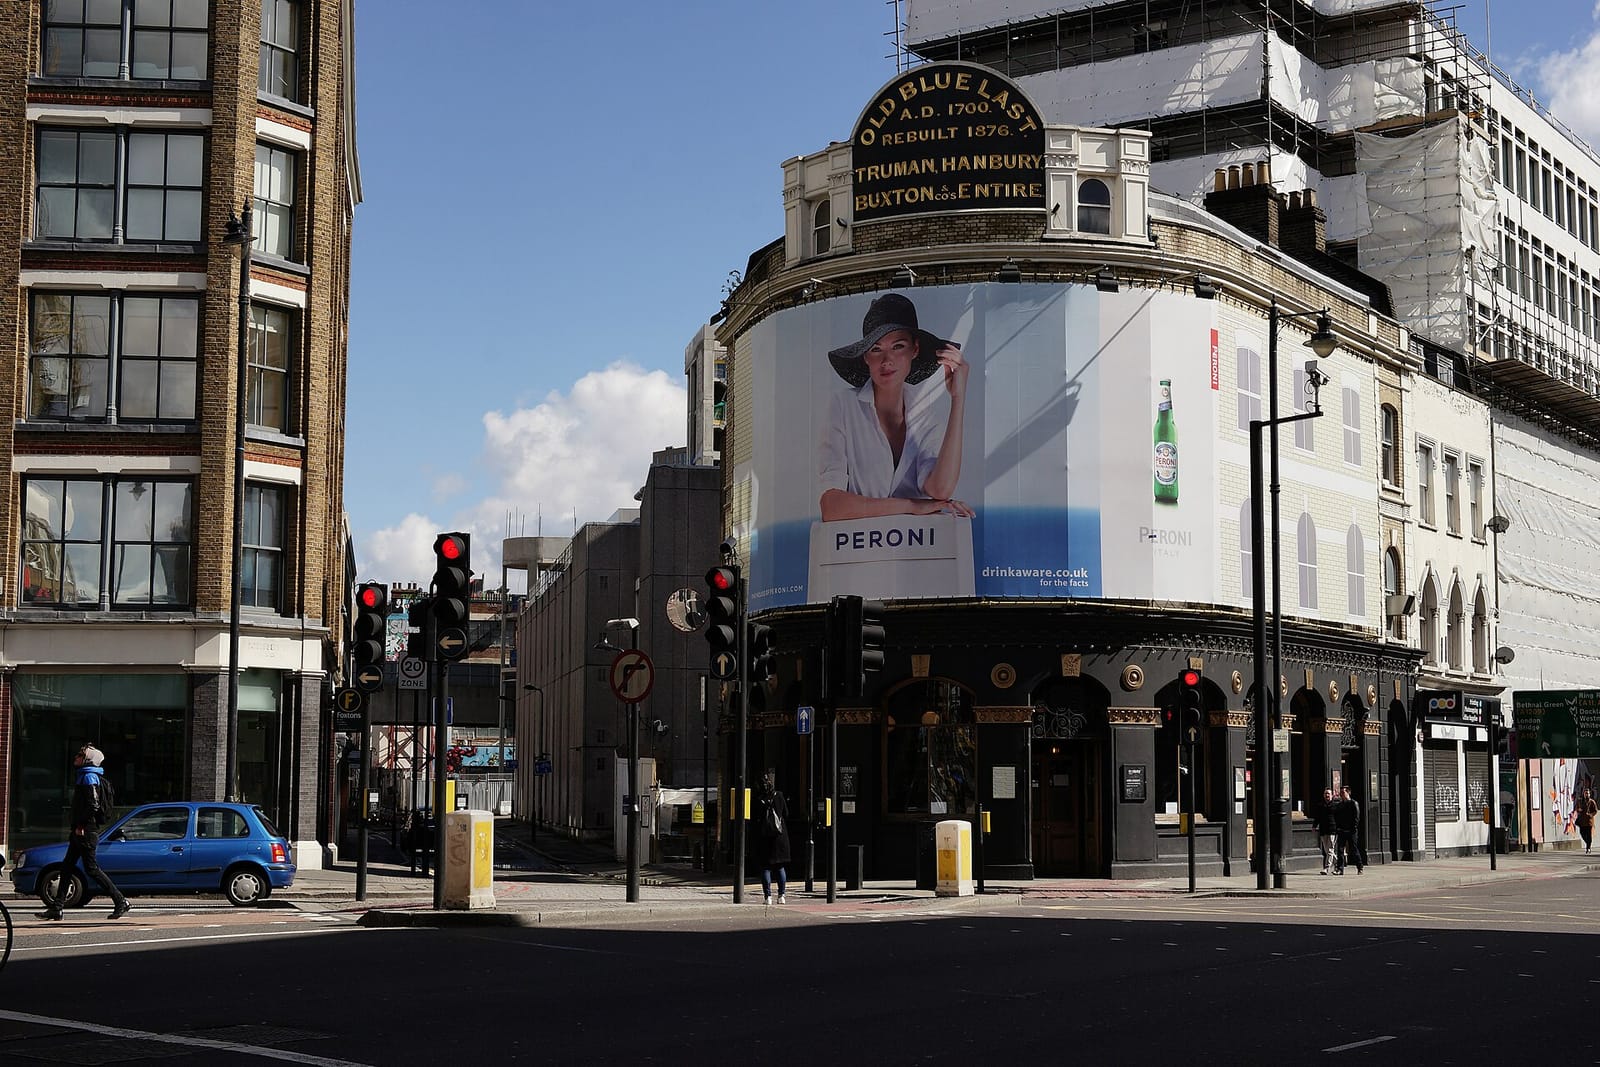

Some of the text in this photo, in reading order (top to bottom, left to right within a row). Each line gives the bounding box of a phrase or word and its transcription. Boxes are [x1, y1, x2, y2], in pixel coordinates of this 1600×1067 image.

[860, 98, 896, 146] OLD
[898, 72, 972, 101] BLUE
[899, 101, 992, 121] A.D. 1700.
[882, 124, 1014, 146] REBUILT 1876.
[855, 158, 938, 184] TRUMAN,
[934, 191, 957, 201] CO'S
[940, 184, 949, 192] &
[855, 186, 934, 212] BUXTON
[836, 527, 935, 551] PERONI
[1138, 526, 1192, 546] PERONI
[982, 566, 1088, 578] drinkaware.co.uk
[1040, 579, 1089, 587] for the facts
[405, 661, 421, 672] 20
[401, 679, 424, 687] ZONE
[344, 692, 355, 709] F
[1428, 694, 1456, 713] pod
[336, 711, 362, 719] Foxtons
